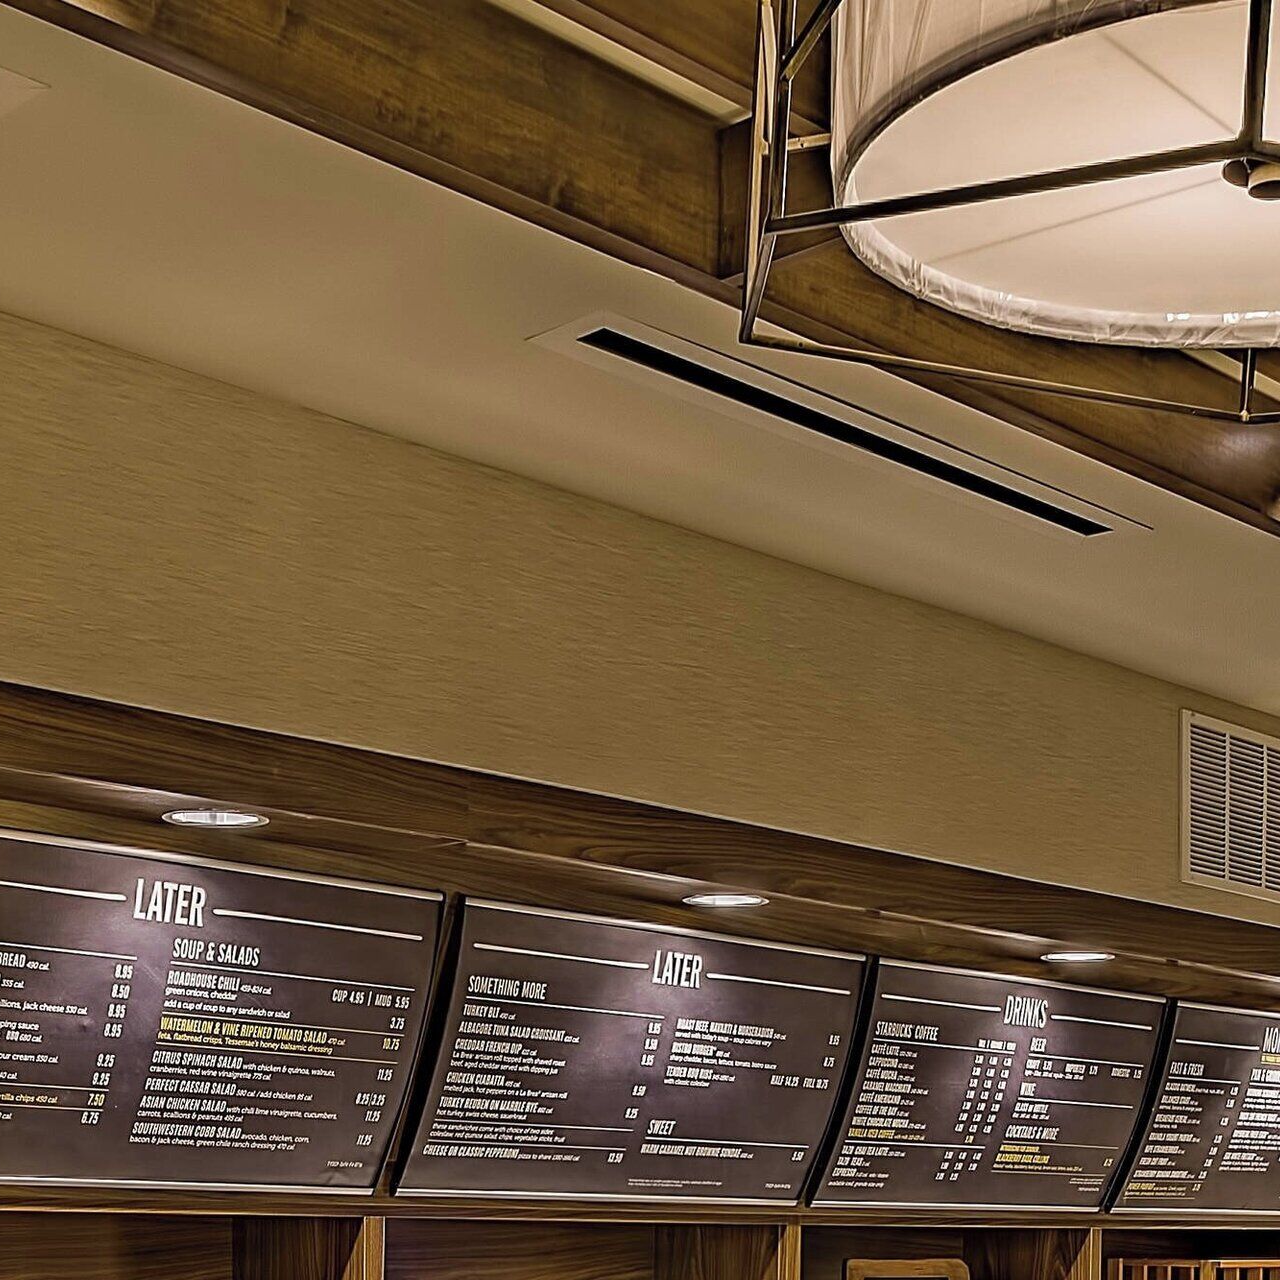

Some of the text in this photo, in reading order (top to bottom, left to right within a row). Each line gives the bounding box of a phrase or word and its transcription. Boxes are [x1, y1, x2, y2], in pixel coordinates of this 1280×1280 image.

[133, 878, 207, 928] LATER
[172, 938, 260, 967] SOUP & SALADS
[652, 949, 703, 989] LATER
[167, 970, 217, 989] ROADHOUSE
[217, 975, 240, 991] CHILI
[332, 989, 346, 1002] CUP
[375, 994, 392, 1007] MUG
[468, 975, 547, 1000] SOMETHING MORE
[38, 1002, 64, 1013] cheese
[463, 1004, 501, 1018] TURKEY BLT
[1003, 995, 1049, 1029] DRINKS
[17, 1022, 39, 1030] sauce
[160, 1016, 213, 1034] WATERMELON
[213, 1021, 221, 1034] &
[221, 1022, 240, 1036] VINE
[239, 1024, 272, 1039] RIPENED
[273, 1027, 302, 1042] TOMATO
[302, 1030, 327, 1044] SALAD
[459, 1021, 565, 1041] ALBACORE TUNA SALAD CROISSANT
[914, 1025, 939, 1041] COFFEE
[5, 1030, 19, 1041] BBQ
[1030, 1037, 1047, 1052] BEER
[11, 1053, 35, 1061] cream
[152, 1050, 181, 1064] CITRUS
[181, 1053, 217, 1067] SPINACH
[216, 1056, 243, 1069] SALAD
[144, 1077, 236, 1095] PERFECT CAESAR SALAD
[140, 1095, 166, 1109] ASIAN
[165, 1097, 201, 1111] CHICKEN
[200, 1099, 226, 1112] SALAD
[132, 1121, 194, 1137] SOUTHWESTERN
[193, 1125, 216, 1138] COBB
[215, 1126, 241, 1139] SALAD
[647, 1119, 676, 1136] SWEET
